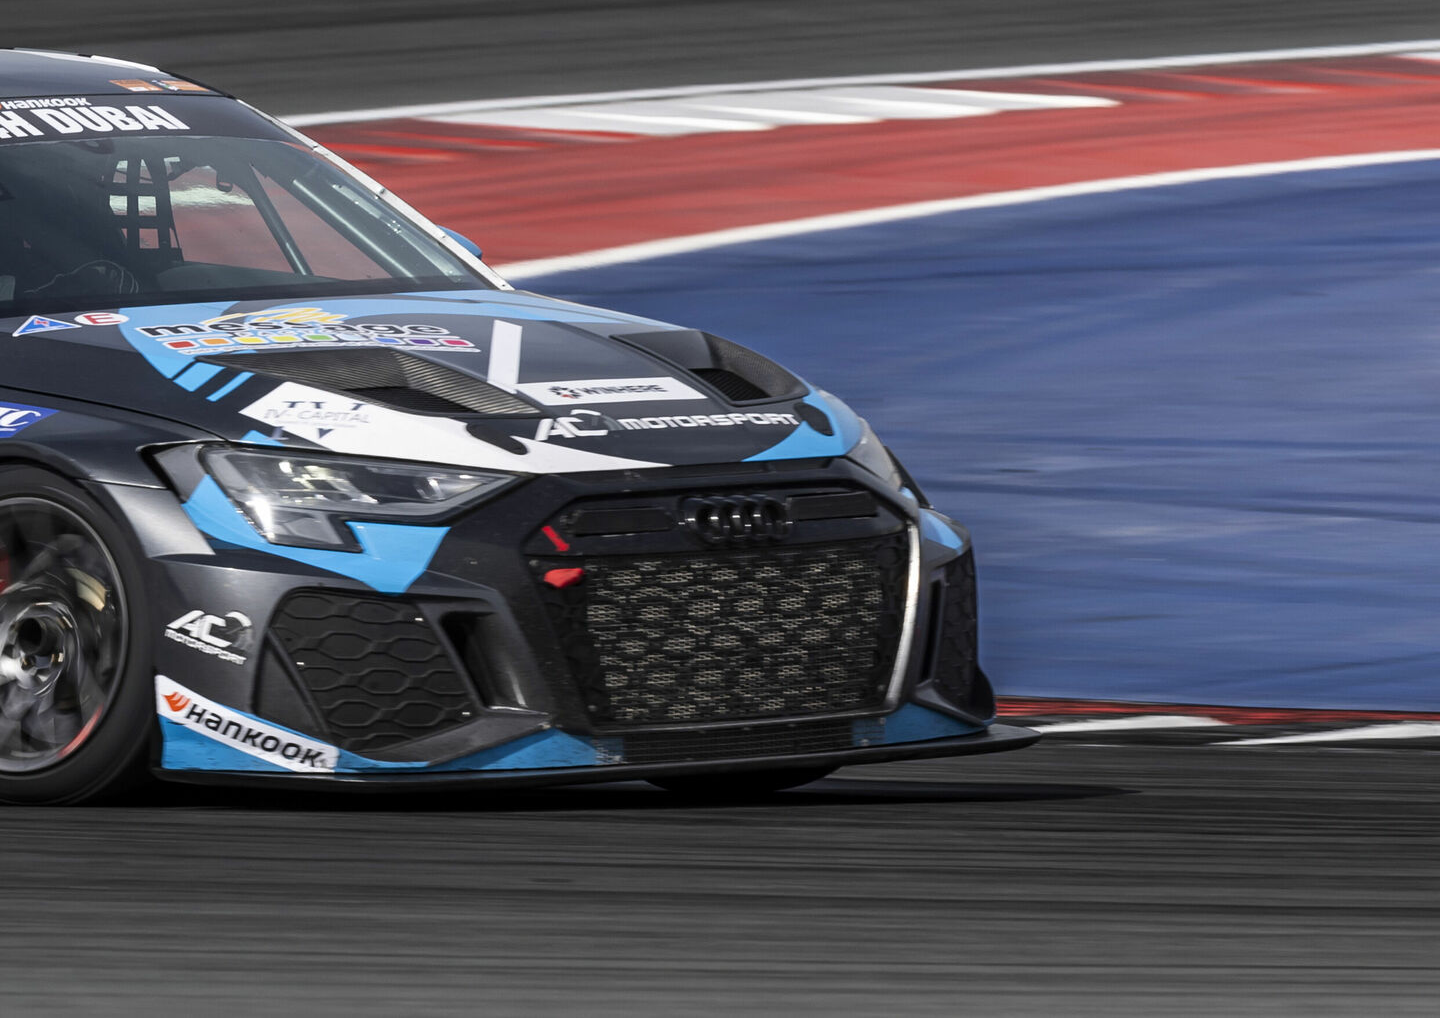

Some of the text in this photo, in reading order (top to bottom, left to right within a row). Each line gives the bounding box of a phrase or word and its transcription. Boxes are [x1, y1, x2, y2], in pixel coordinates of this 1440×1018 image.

[30, 105, 190, 134] DUBAI
[534, 413, 800, 441] AC MOTORSPORT
[167, 610, 232, 648] AC
